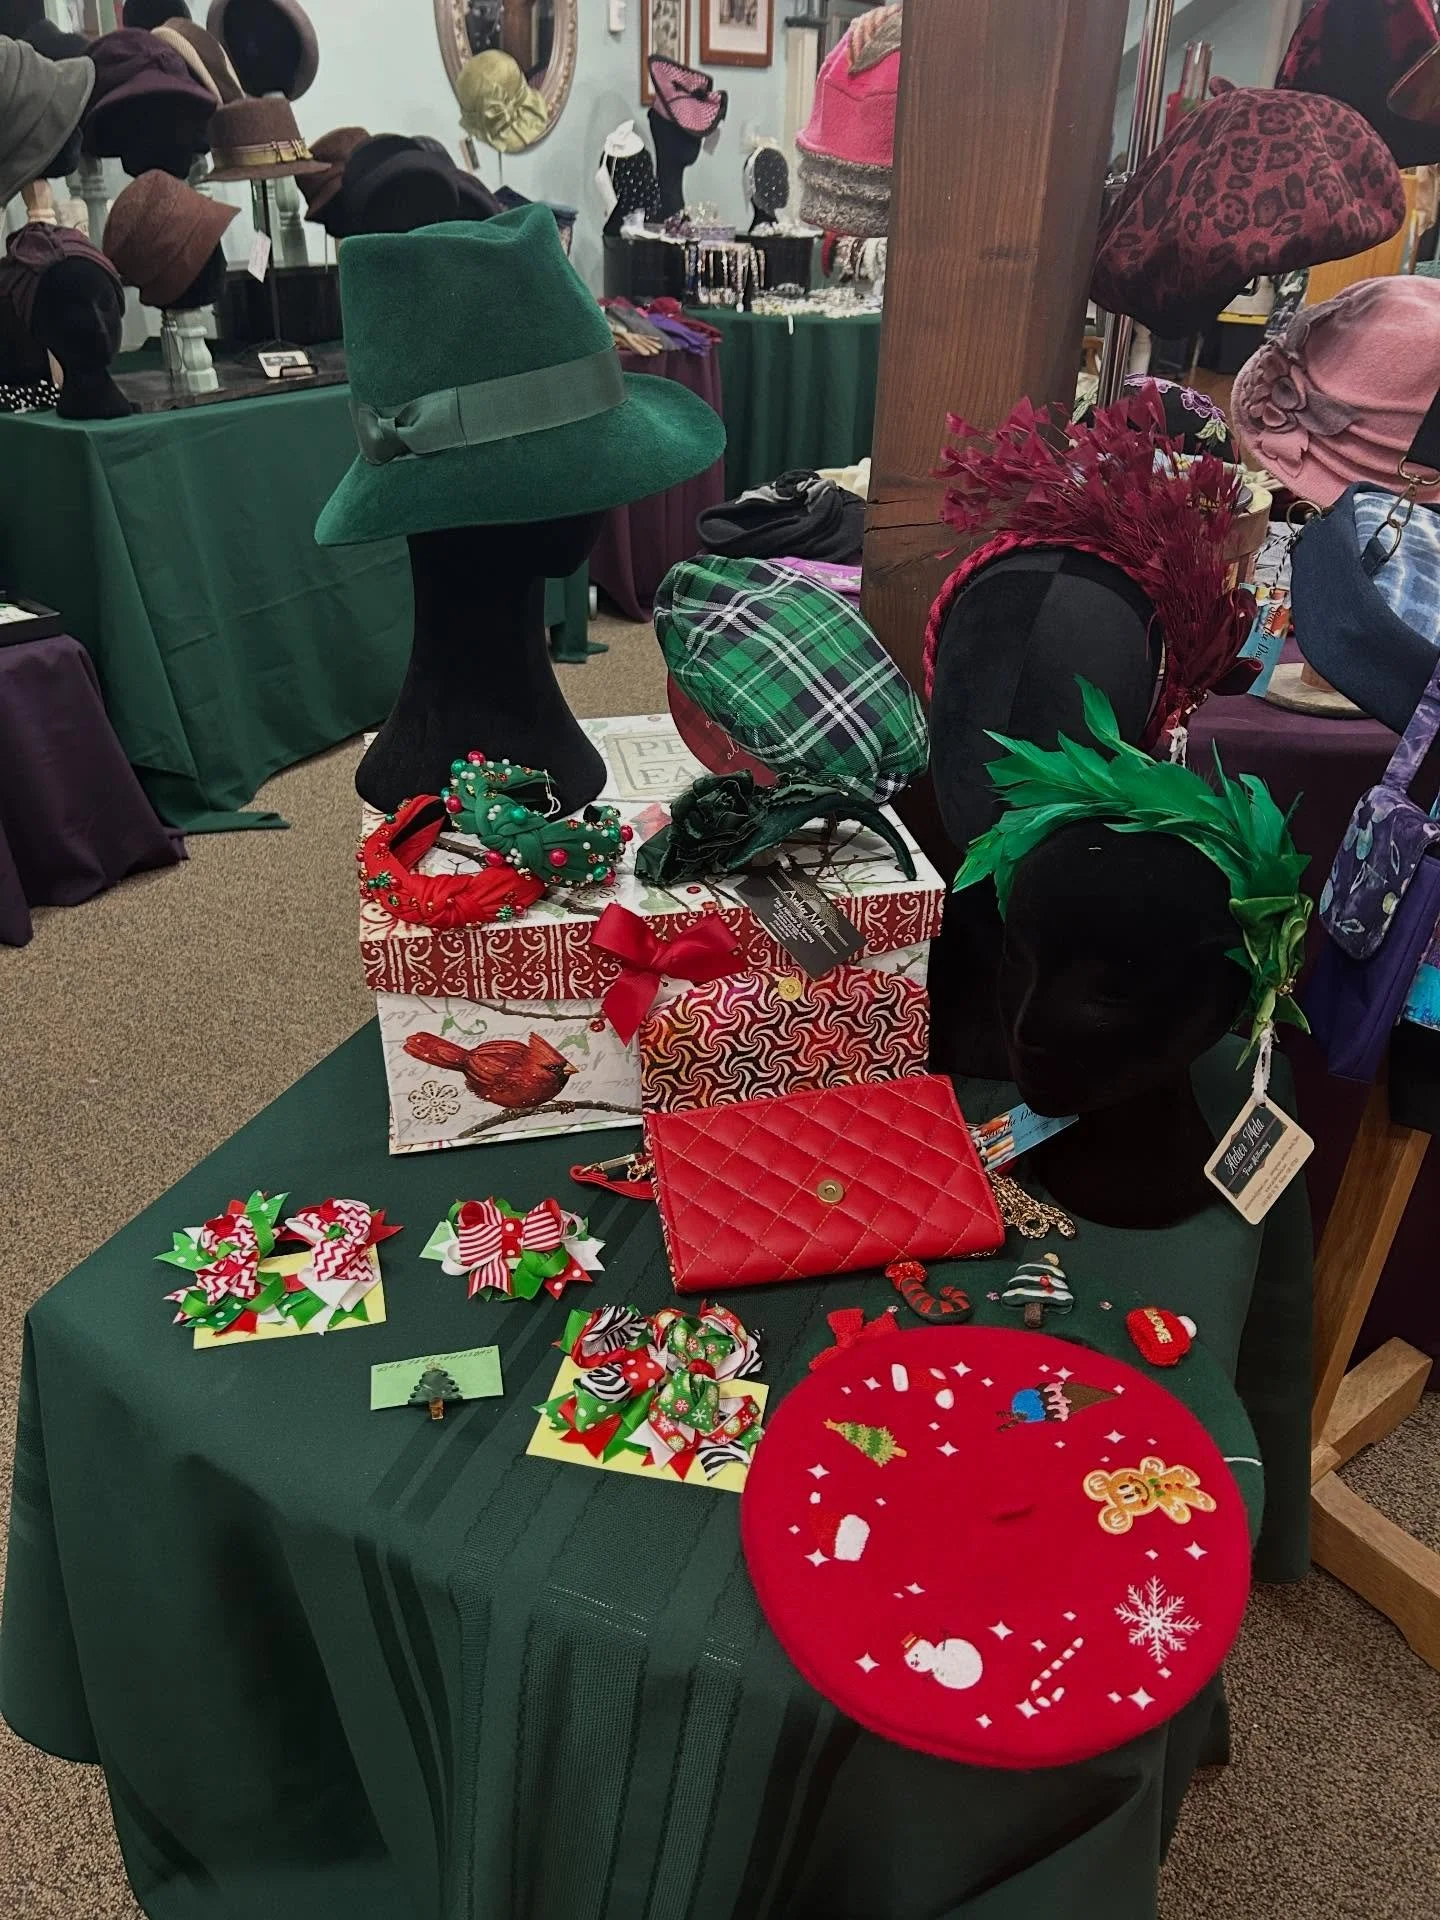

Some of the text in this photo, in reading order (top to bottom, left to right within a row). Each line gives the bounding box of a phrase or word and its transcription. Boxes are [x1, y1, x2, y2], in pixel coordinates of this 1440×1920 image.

[631, 738, 688, 757] PE
[639, 765, 698, 785] EA
[783, 890, 808, 916] Atelier
[805, 912, 828, 936] Mela
[1224, 1118, 1265, 1176] Atelier Mela
[1242, 1164, 1253, 1176] Fine
[1143, 1309, 1173, 1344] LOVE
